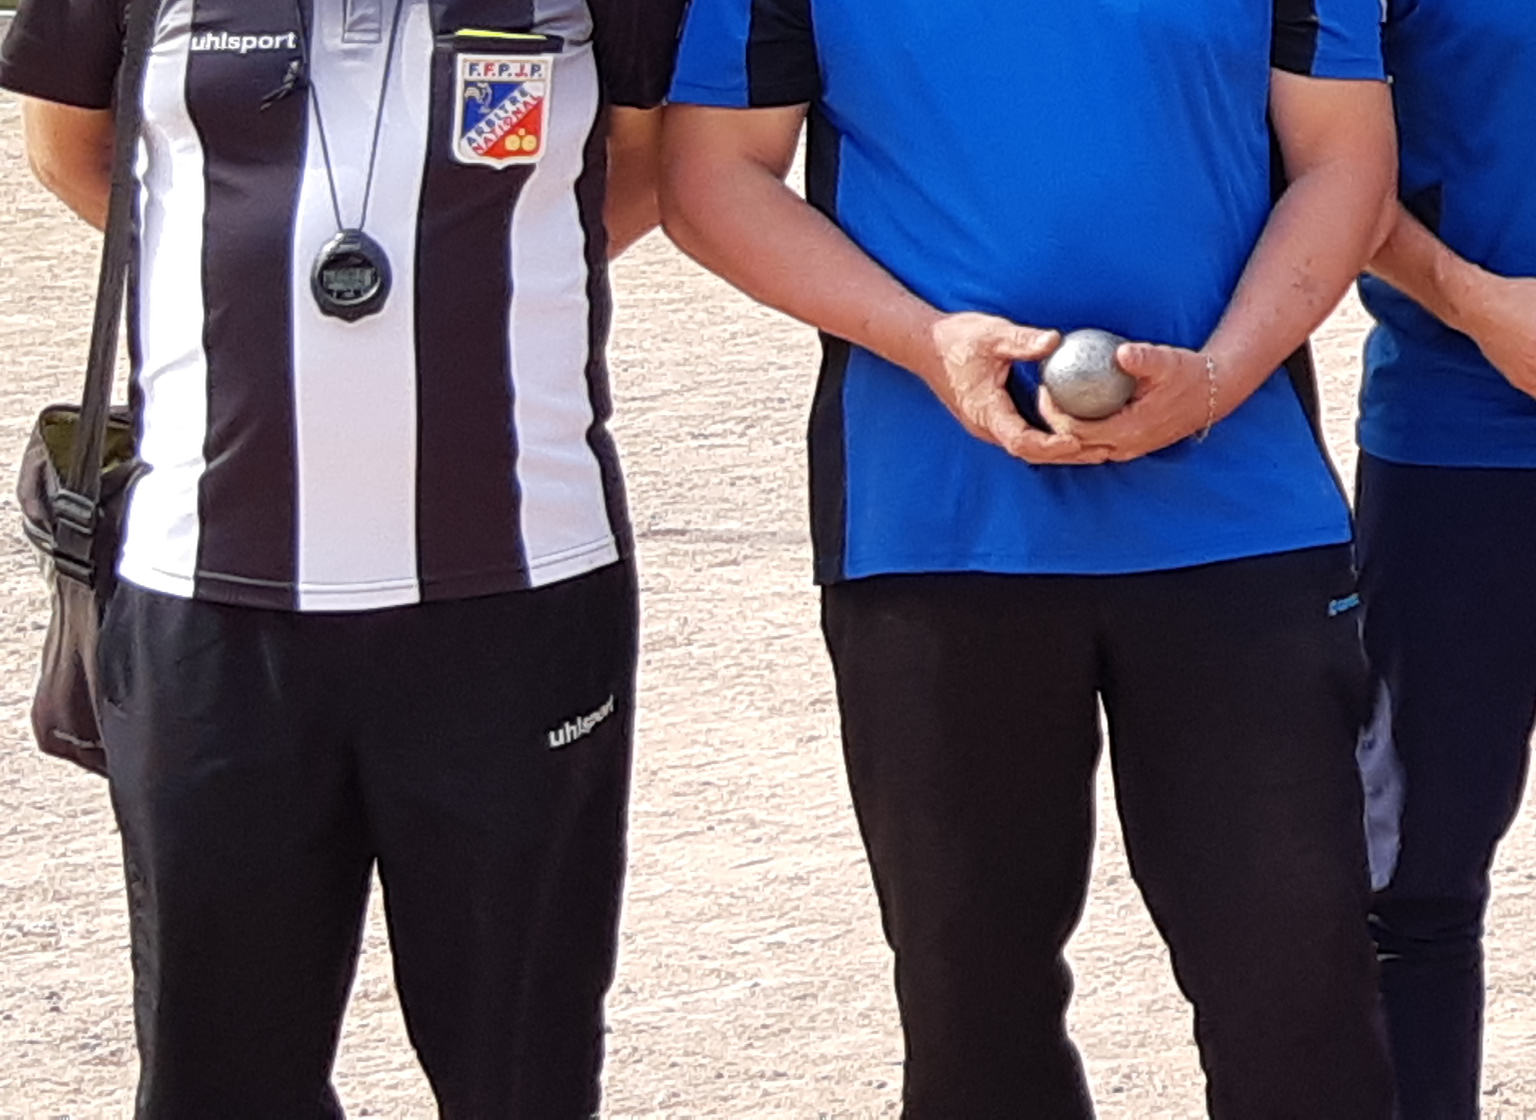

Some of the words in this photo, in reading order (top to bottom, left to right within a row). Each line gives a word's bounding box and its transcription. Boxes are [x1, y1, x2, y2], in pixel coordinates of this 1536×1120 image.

[191, 31, 297, 54] uhlsport
[468, 63, 542, 77] F.F.P.J.P.
[466, 86, 530, 147] ARBITRE
[472, 94, 542, 155] NATIONAL
